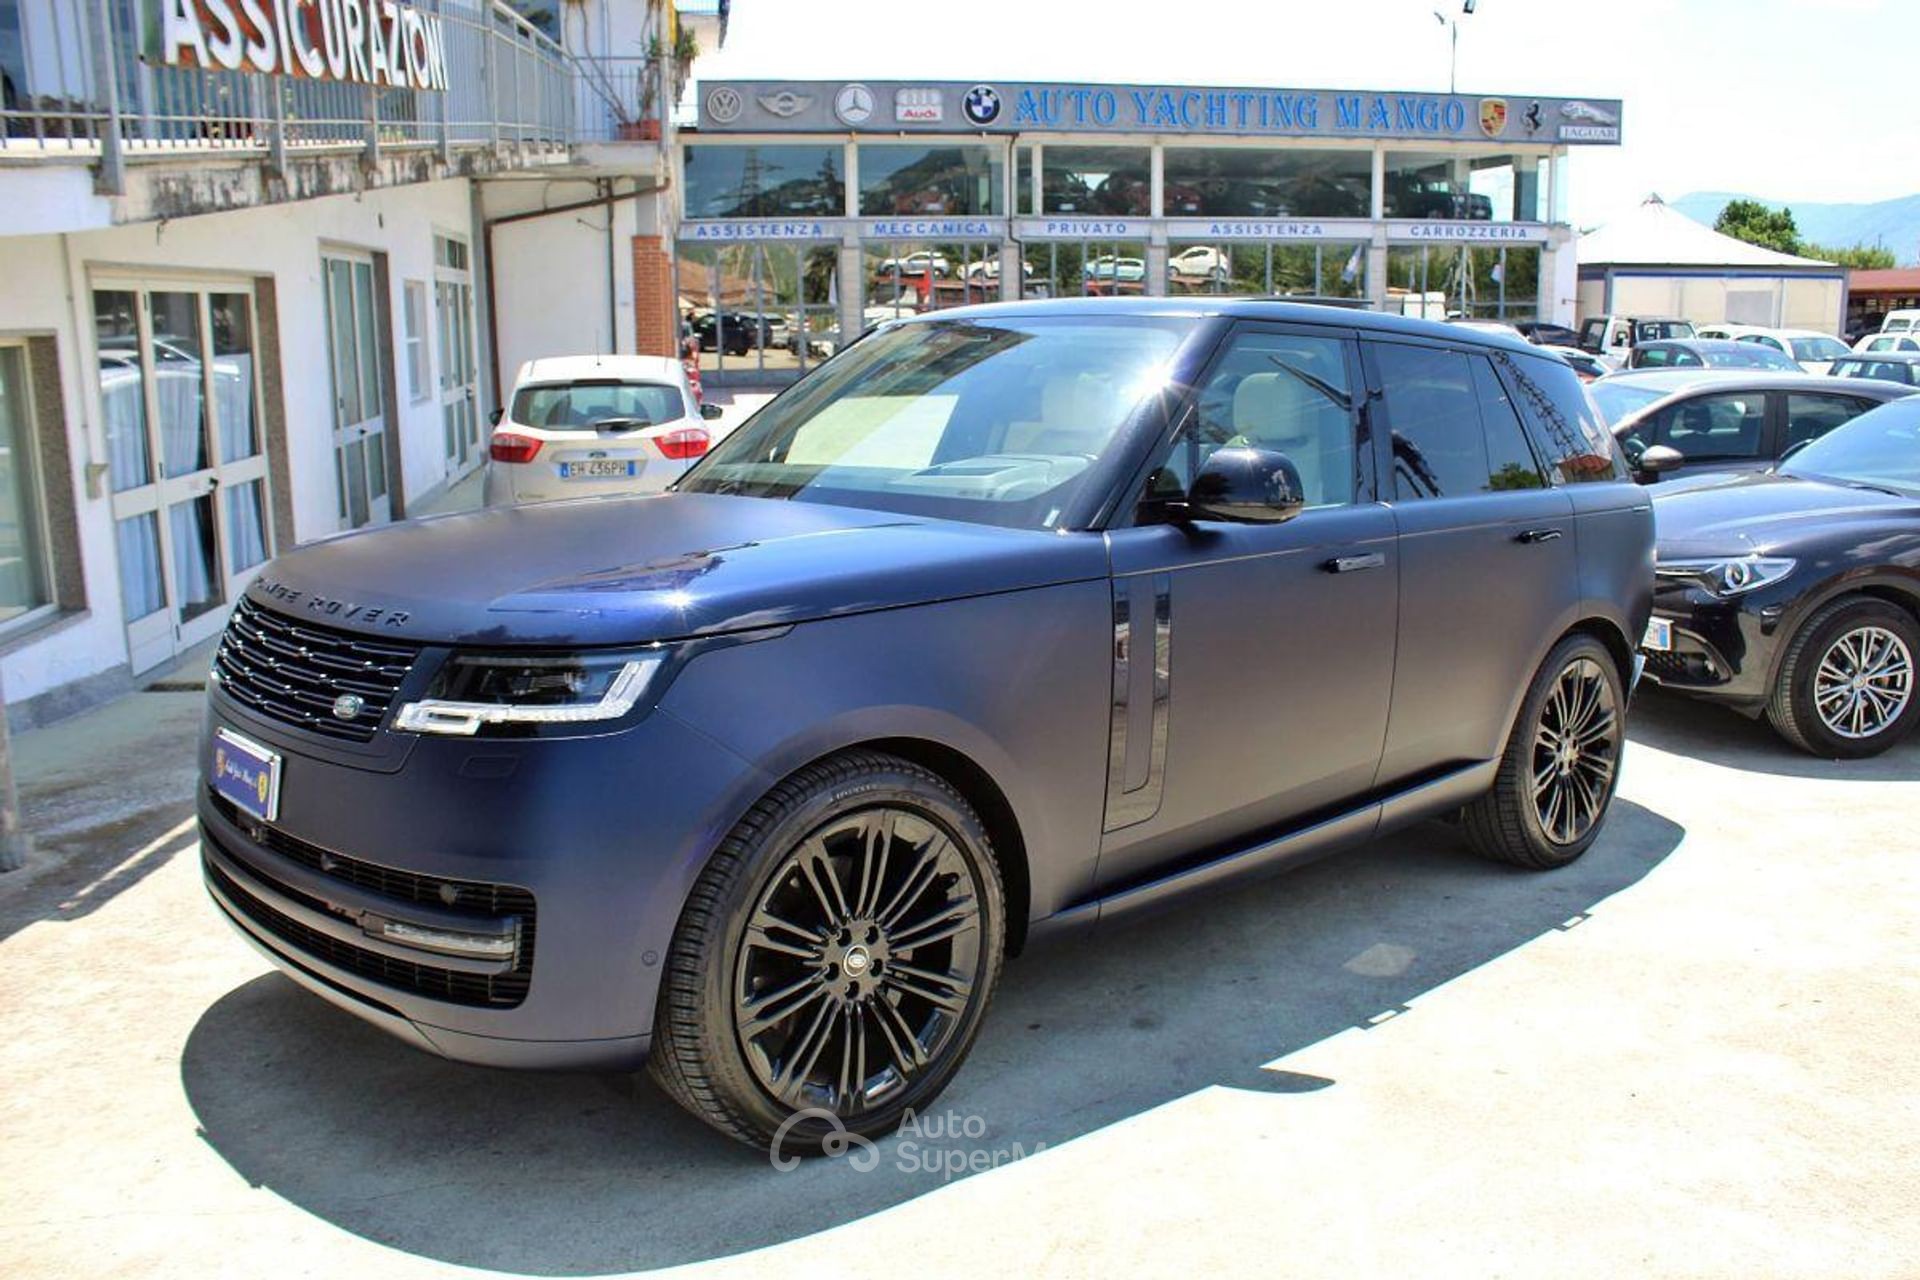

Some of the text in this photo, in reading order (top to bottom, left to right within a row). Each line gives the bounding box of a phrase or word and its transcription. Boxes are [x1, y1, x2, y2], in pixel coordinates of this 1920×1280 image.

[164, 0, 448, 90] ASSICURAZIONI
[903, 109, 937, 118] Audi
[1014, 88, 1118, 125] AUTO
[1131, 90, 1319, 129] YACHTING
[1334, 96, 1466, 133] MANGO
[1563, 126, 1618, 139] JAGUAR
[696, 223, 823, 237] ASSISTENZA
[873, 222, 989, 235] MECCANICA
[1047, 222, 1127, 235] PRIVATO
[1210, 223, 1323, 236] ASSISTENZA
[1409, 225, 1528, 239] CARROZZERIA
[307, 596, 410, 627] ROVER
